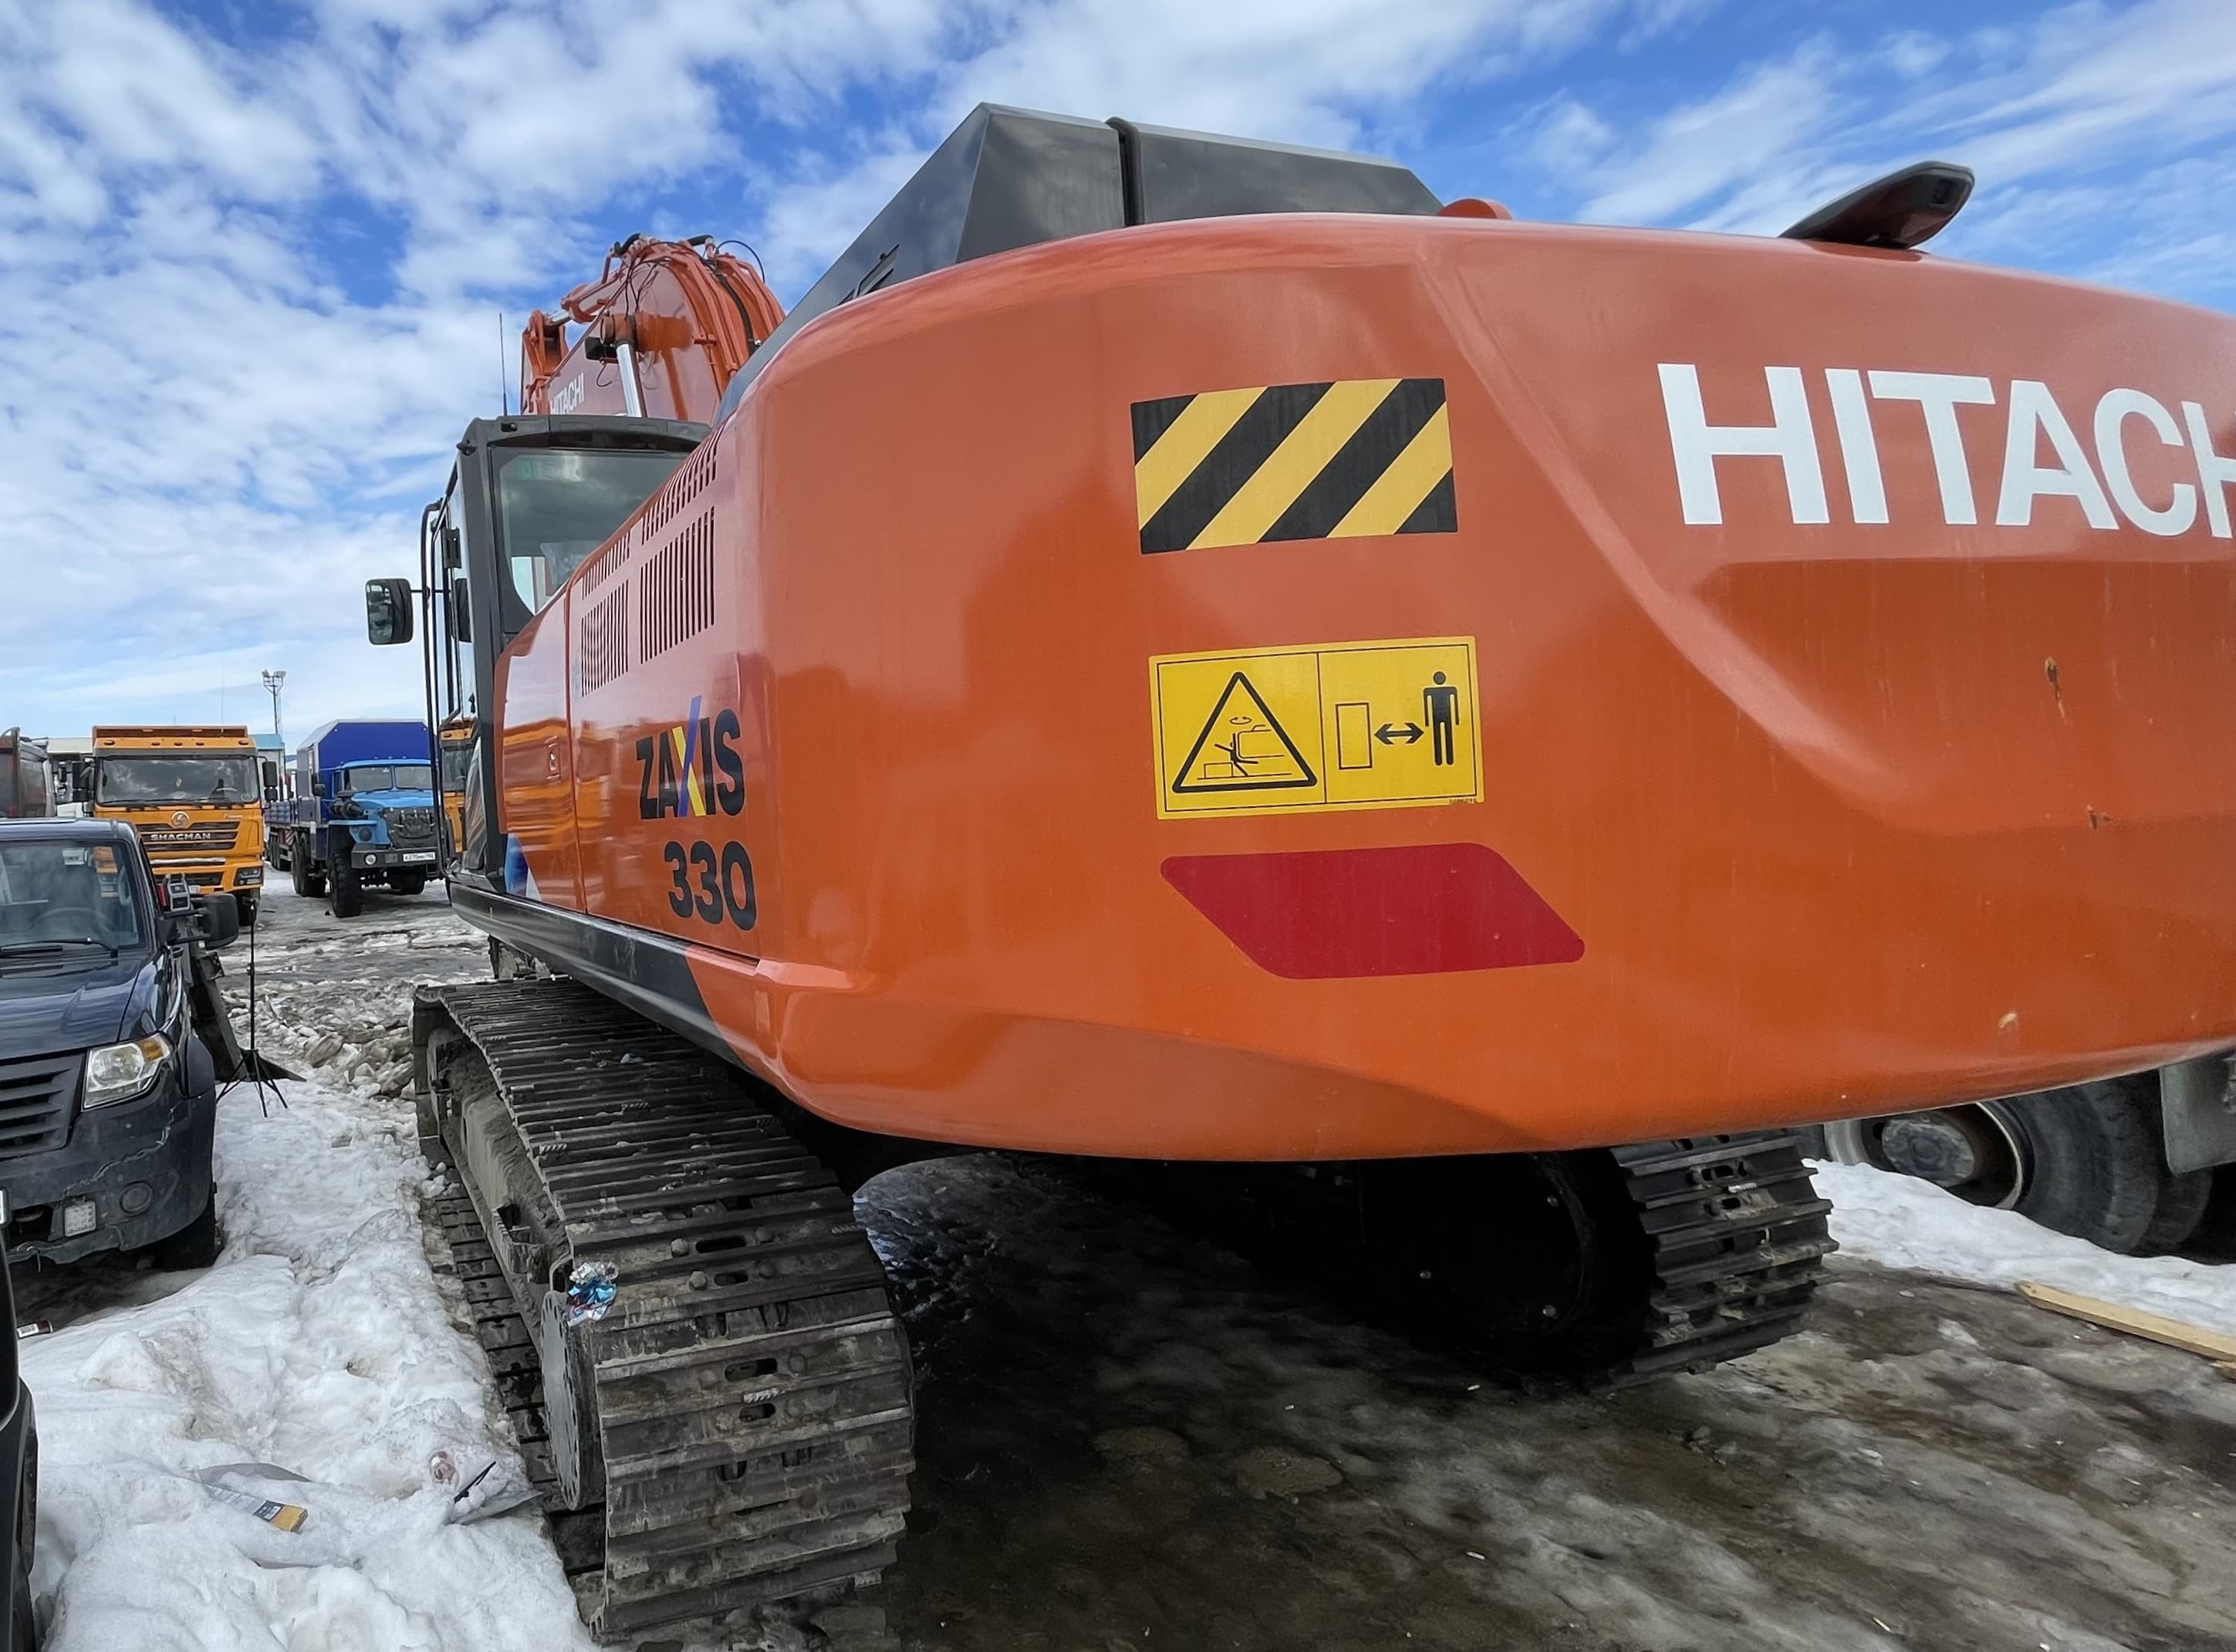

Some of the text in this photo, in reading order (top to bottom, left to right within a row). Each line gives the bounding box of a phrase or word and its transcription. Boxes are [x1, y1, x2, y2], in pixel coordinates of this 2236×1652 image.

[636, 695, 745, 819] ZAXIS
[150, 833, 211, 841] SHACMAN
[664, 840, 757, 931] 330
